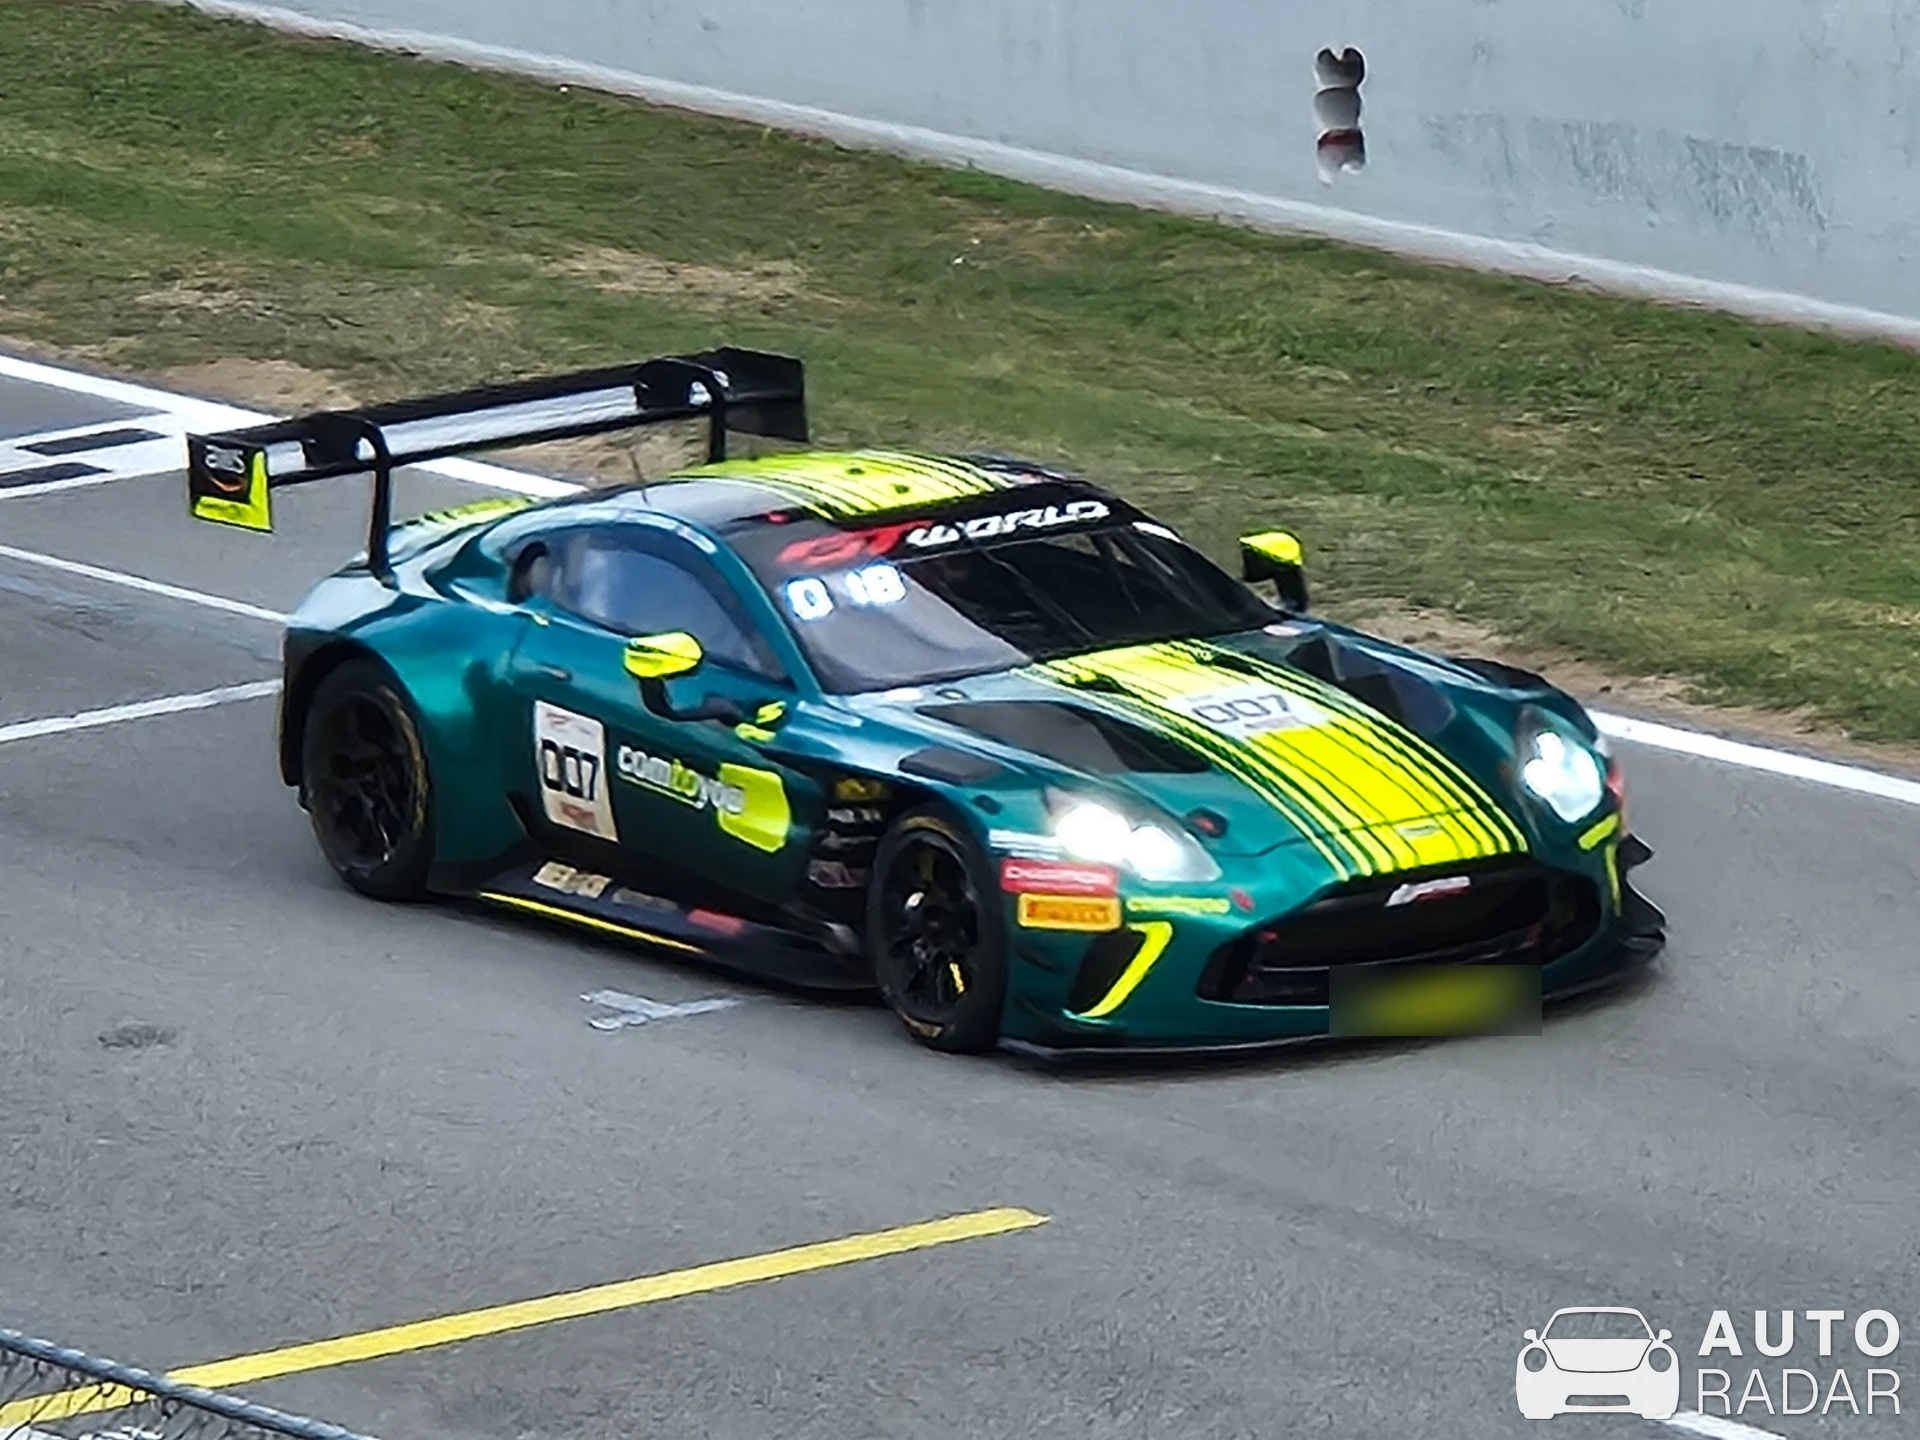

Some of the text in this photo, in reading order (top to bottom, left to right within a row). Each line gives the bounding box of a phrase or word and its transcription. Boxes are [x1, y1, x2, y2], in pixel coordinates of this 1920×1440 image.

[905, 500, 1110, 548] WORLD
[1191, 694, 1291, 724] 007
[540, 738, 599, 801] 007
